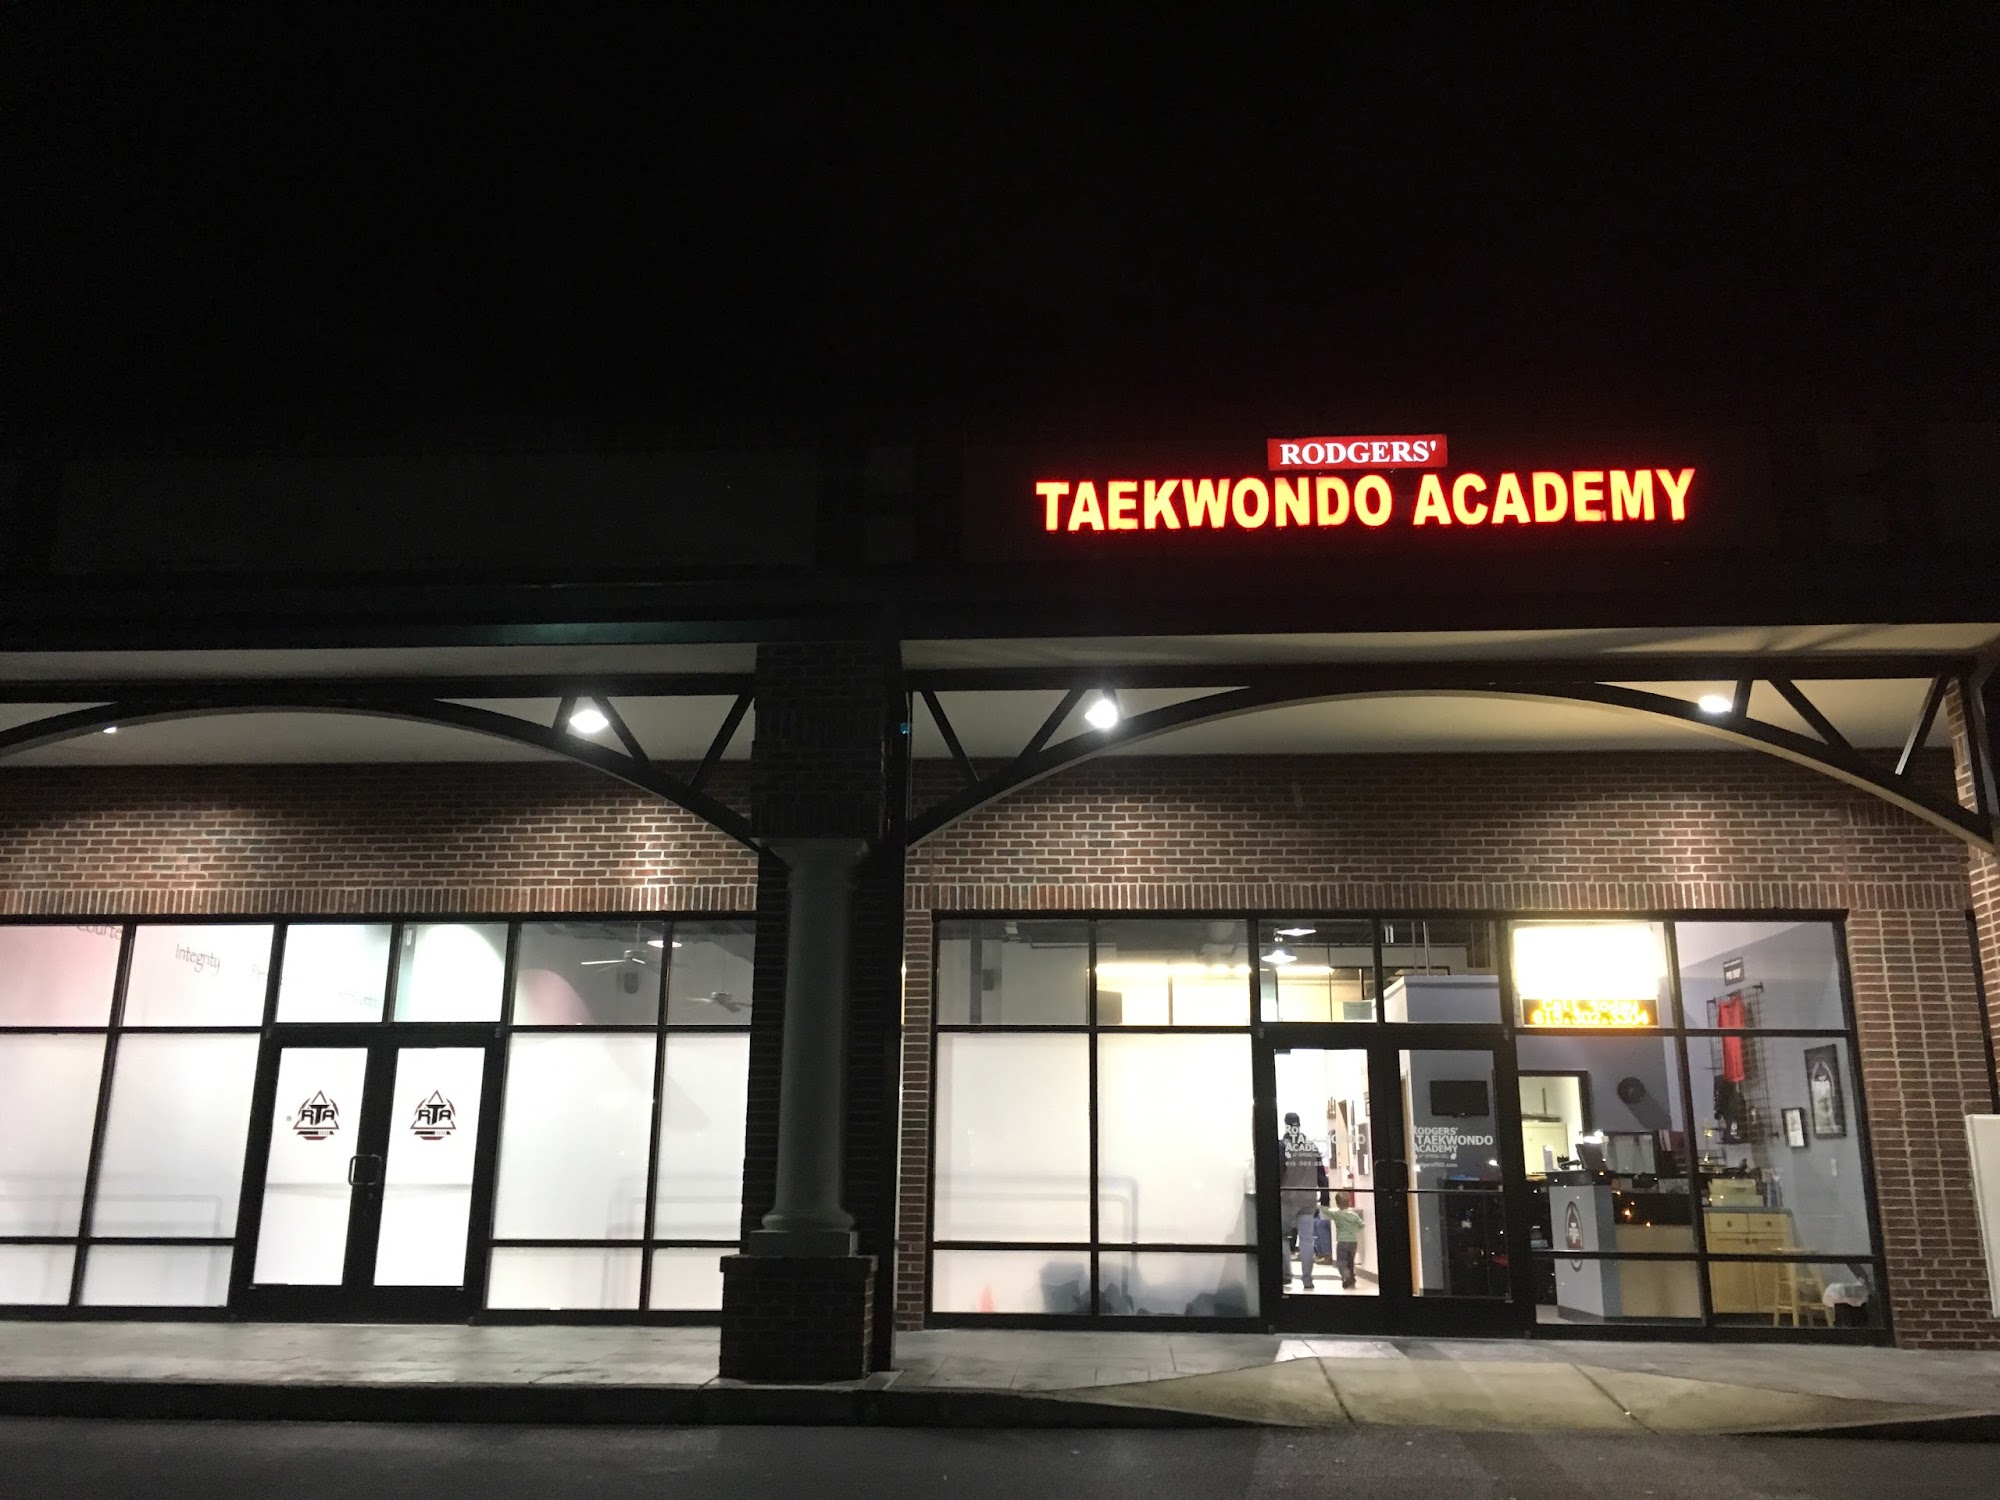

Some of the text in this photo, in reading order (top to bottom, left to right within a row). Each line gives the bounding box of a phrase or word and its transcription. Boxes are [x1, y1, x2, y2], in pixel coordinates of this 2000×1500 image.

[1279, 440, 1437, 465] RODGERS'
[1036, 468, 1697, 532] TAEKWONDO ACADEMY
[76, 925, 124, 941] ourte
[175, 943, 221, 974] Integrity
[301, 1104, 335, 1126] RTA
[417, 1104, 452, 1126] RTA
[1285, 1142, 1319, 1152] ACADE
[1413, 1143, 1458, 1153] ACADEMY
[1416, 1135, 1494, 1146] TAEKWONDO
